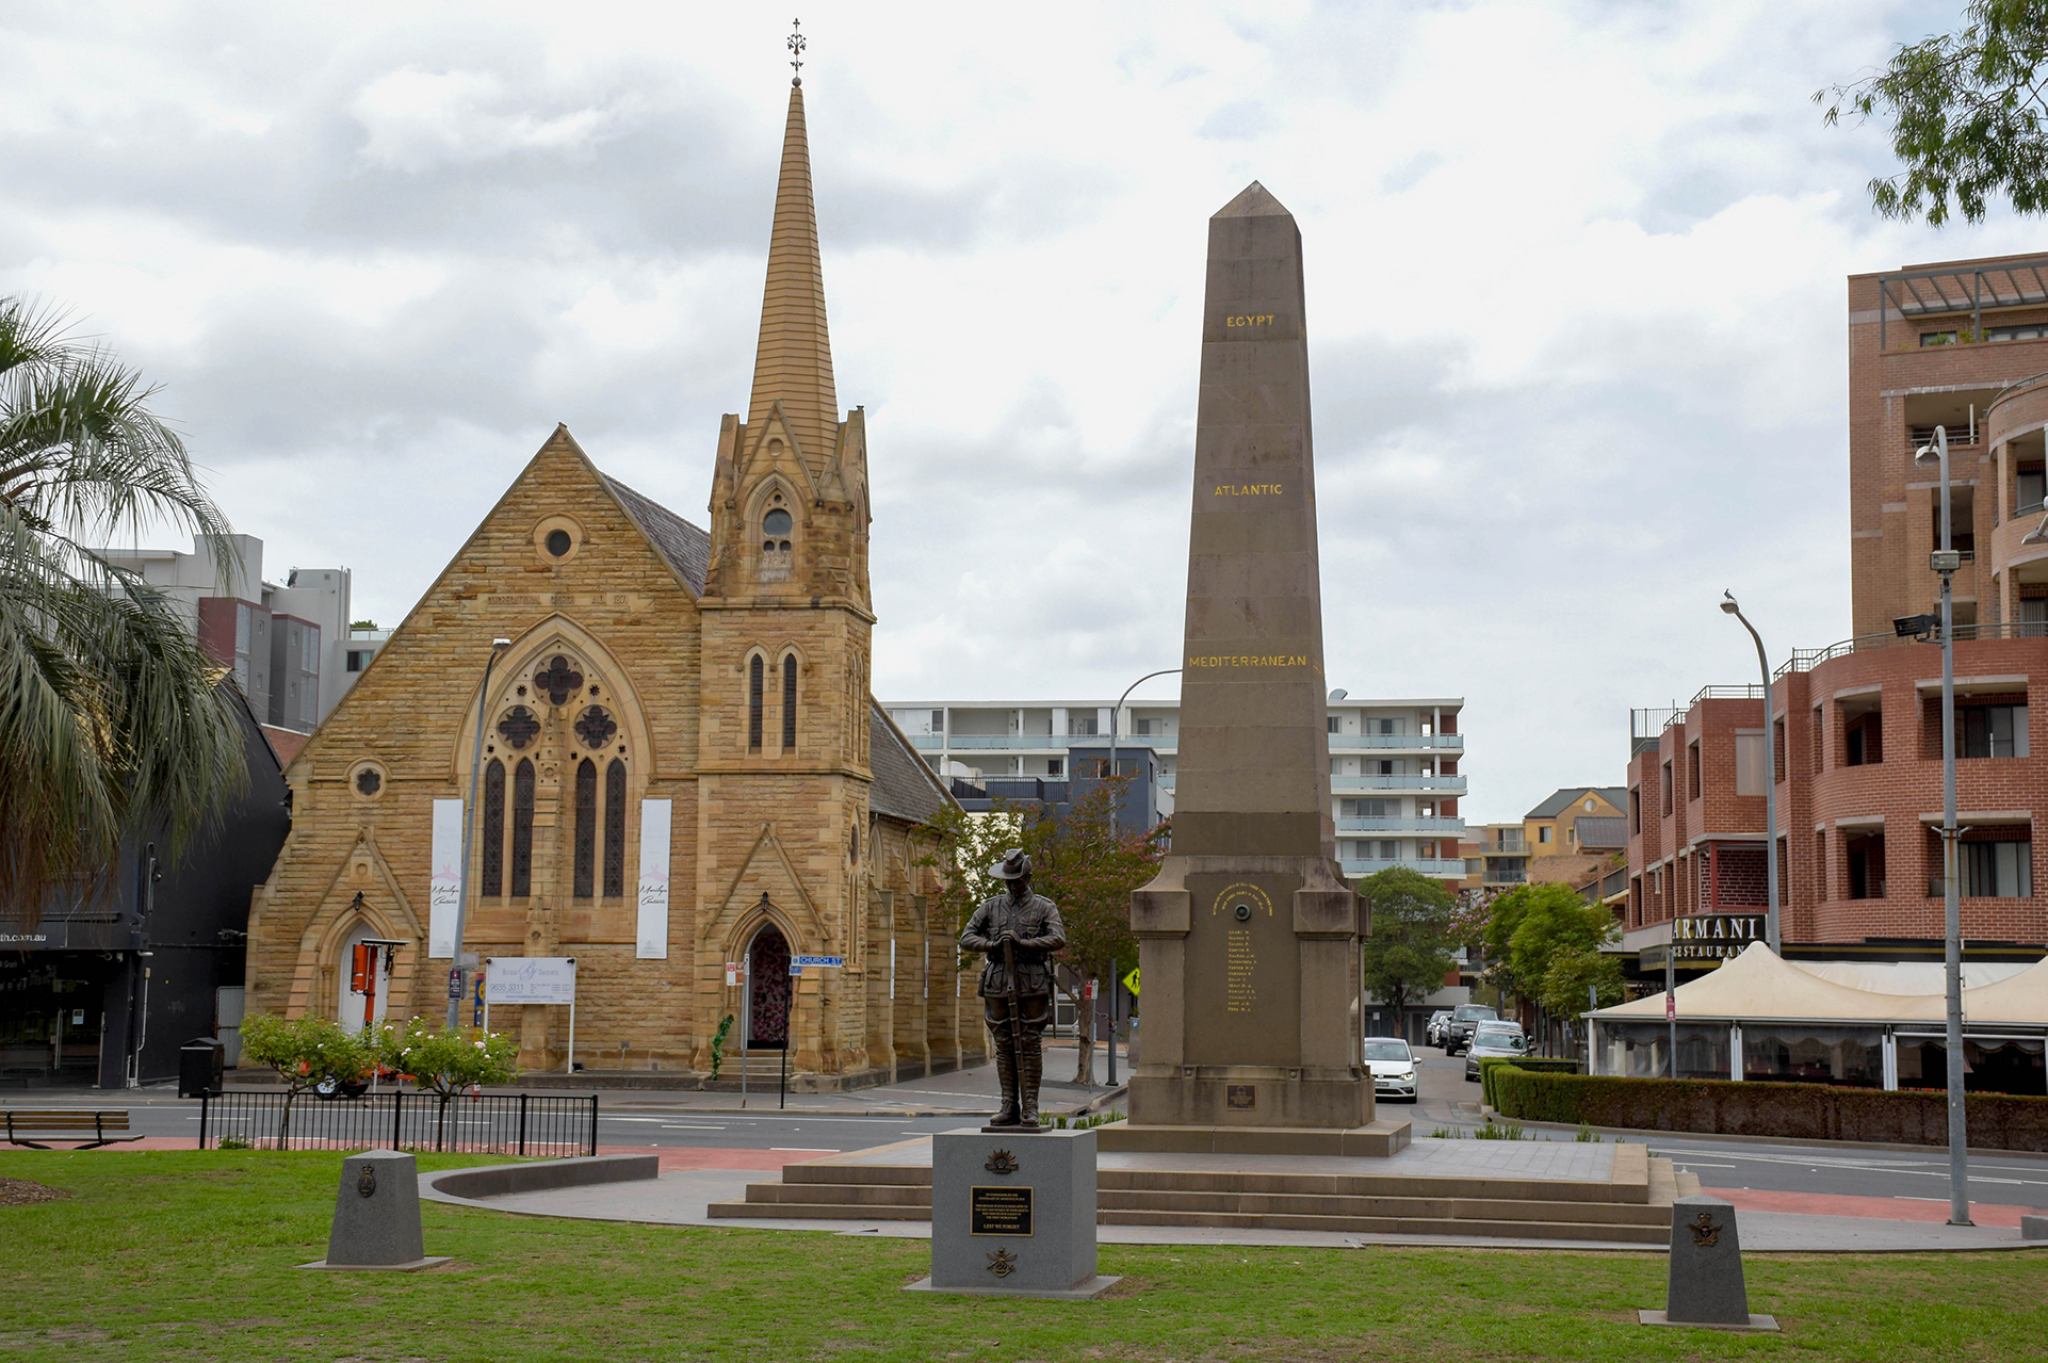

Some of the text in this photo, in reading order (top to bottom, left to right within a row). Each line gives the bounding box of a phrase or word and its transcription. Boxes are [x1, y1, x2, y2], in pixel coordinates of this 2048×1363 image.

[1227, 314, 1275, 327] EGYPT
[1214, 484, 1283, 496] ATLANTIC
[1189, 655, 1307, 667] MEDITERRANEAN
[1672, 918, 1756, 939] ARMANI
[1672, 945, 1745, 958] RESTAURAN
[800, 956, 842, 965] CHURCH ST
[489, 983, 507, 992] 9635
[508, 983, 524, 992] 3311
